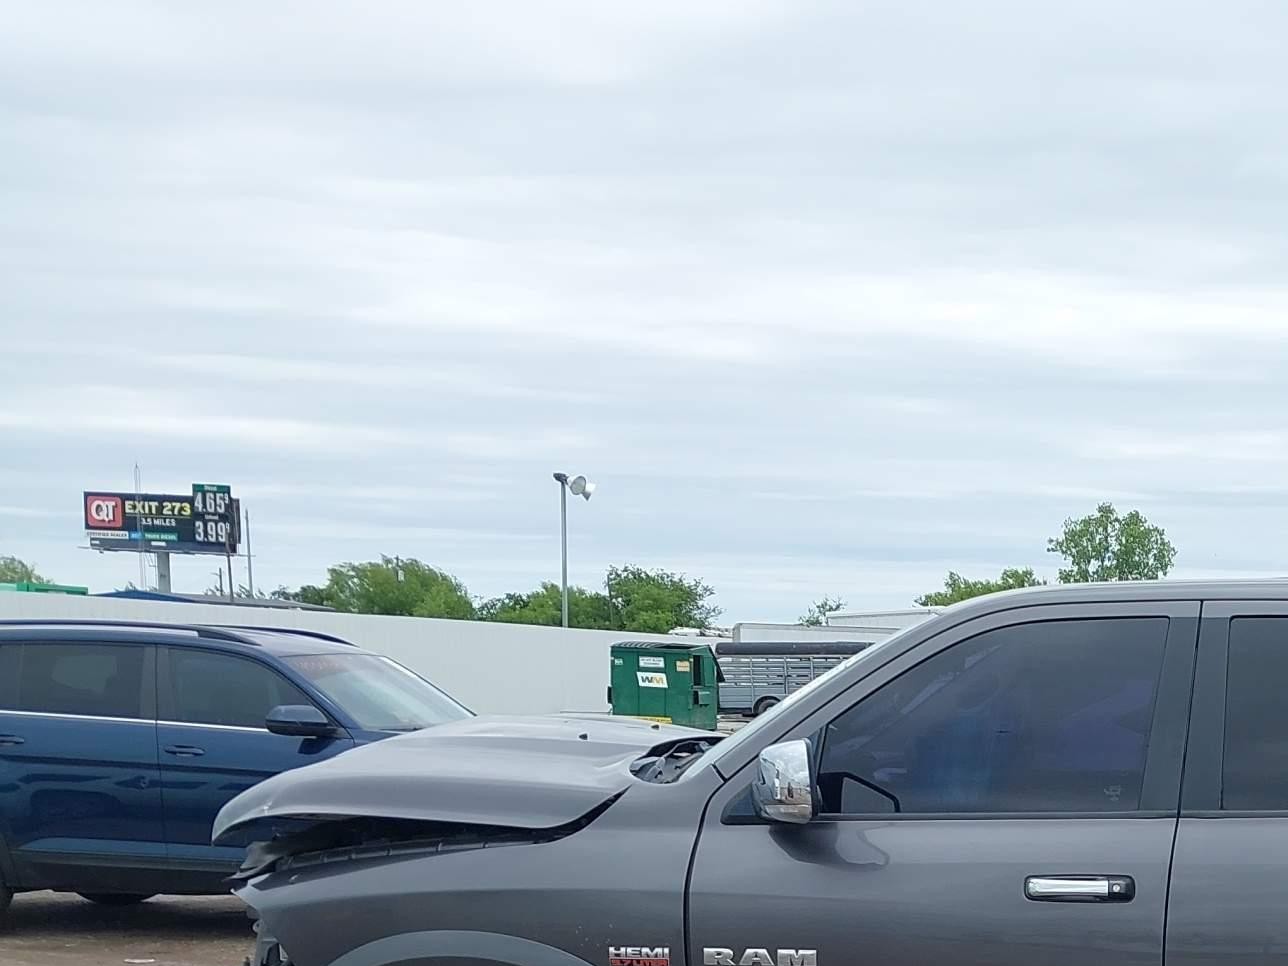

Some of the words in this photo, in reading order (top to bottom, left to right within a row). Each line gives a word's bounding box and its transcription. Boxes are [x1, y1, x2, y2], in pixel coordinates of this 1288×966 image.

[91, 499, 115, 523] QT
[125, 500, 159, 514] EXIT
[162, 501, 191, 516] 273
[153, 517, 176, 527] MILES
[641, 676, 664, 684] WM
[608, 946, 670, 958] HEMI
[703, 947, 817, 966] RAM
